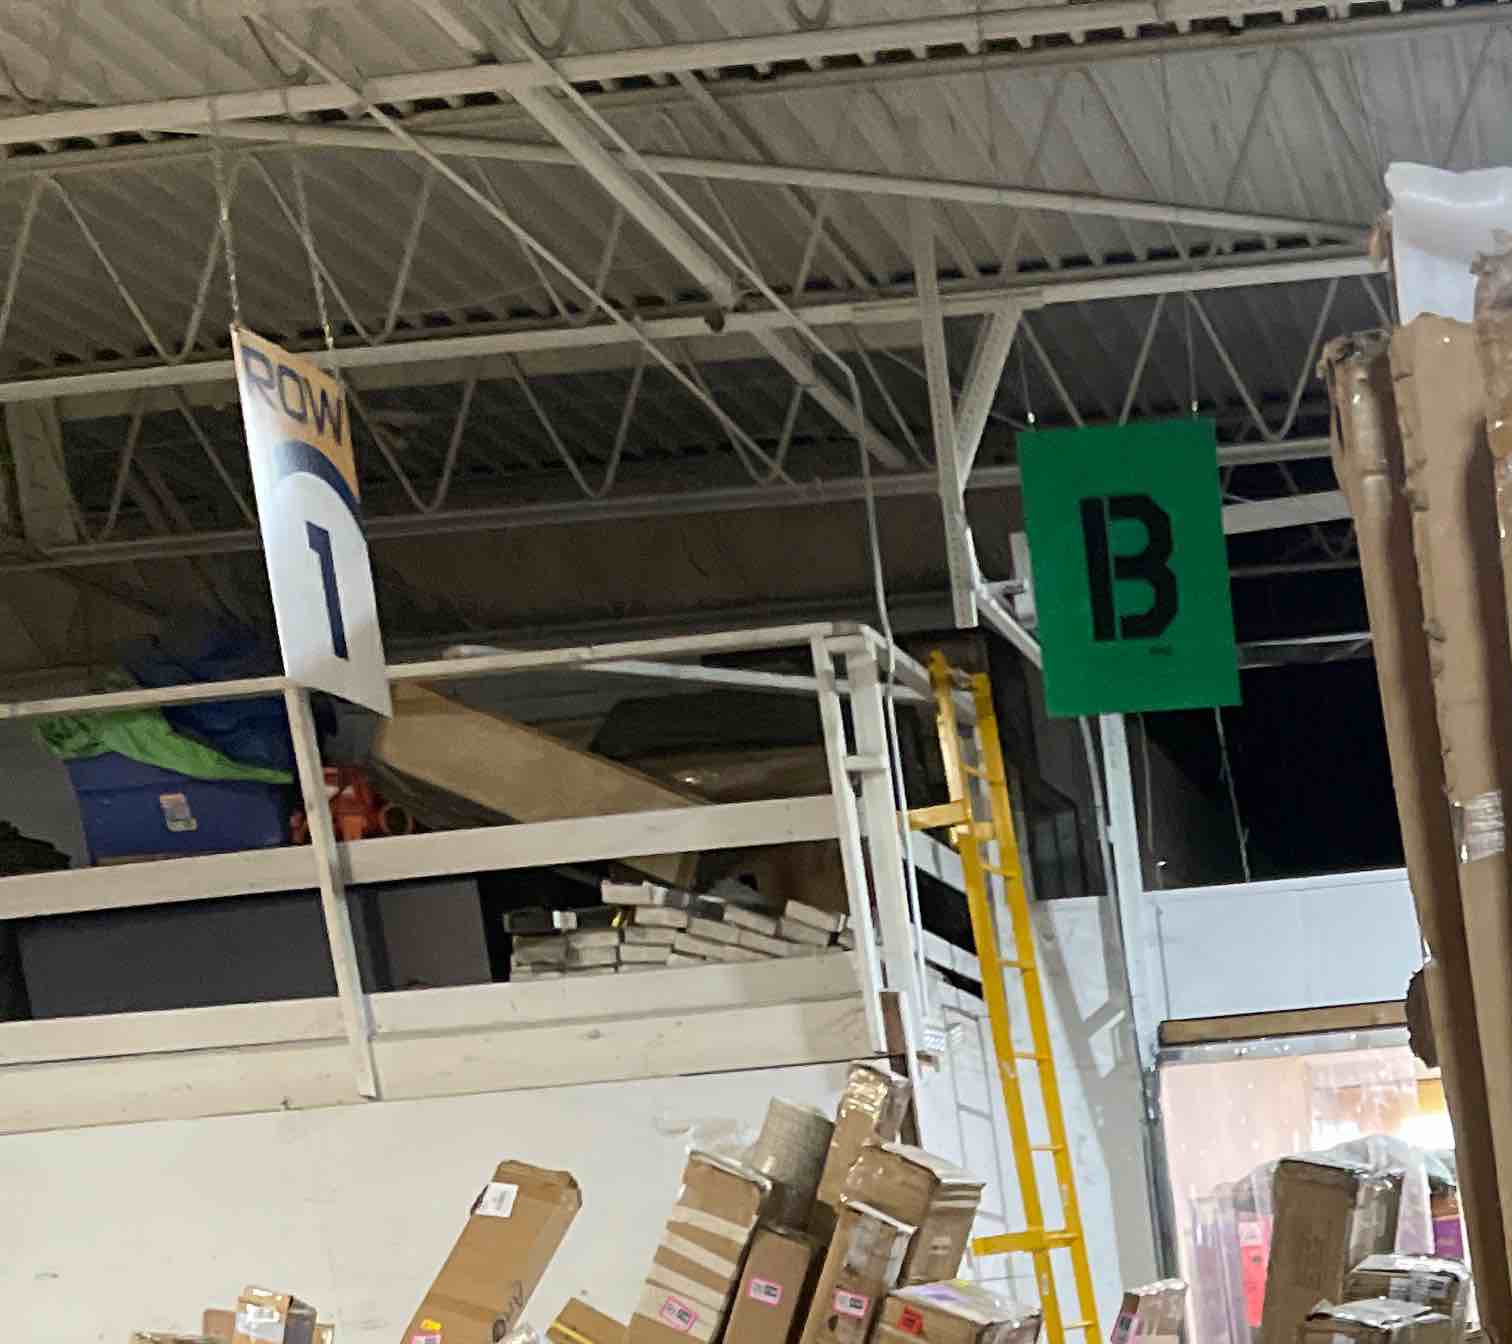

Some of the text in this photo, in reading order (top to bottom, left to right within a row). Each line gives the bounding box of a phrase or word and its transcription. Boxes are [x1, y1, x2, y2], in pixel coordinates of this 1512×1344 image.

[241, 345, 345, 447] ROW
[305, 520, 349, 661] 1
[1078, 494, 1179, 642] B
